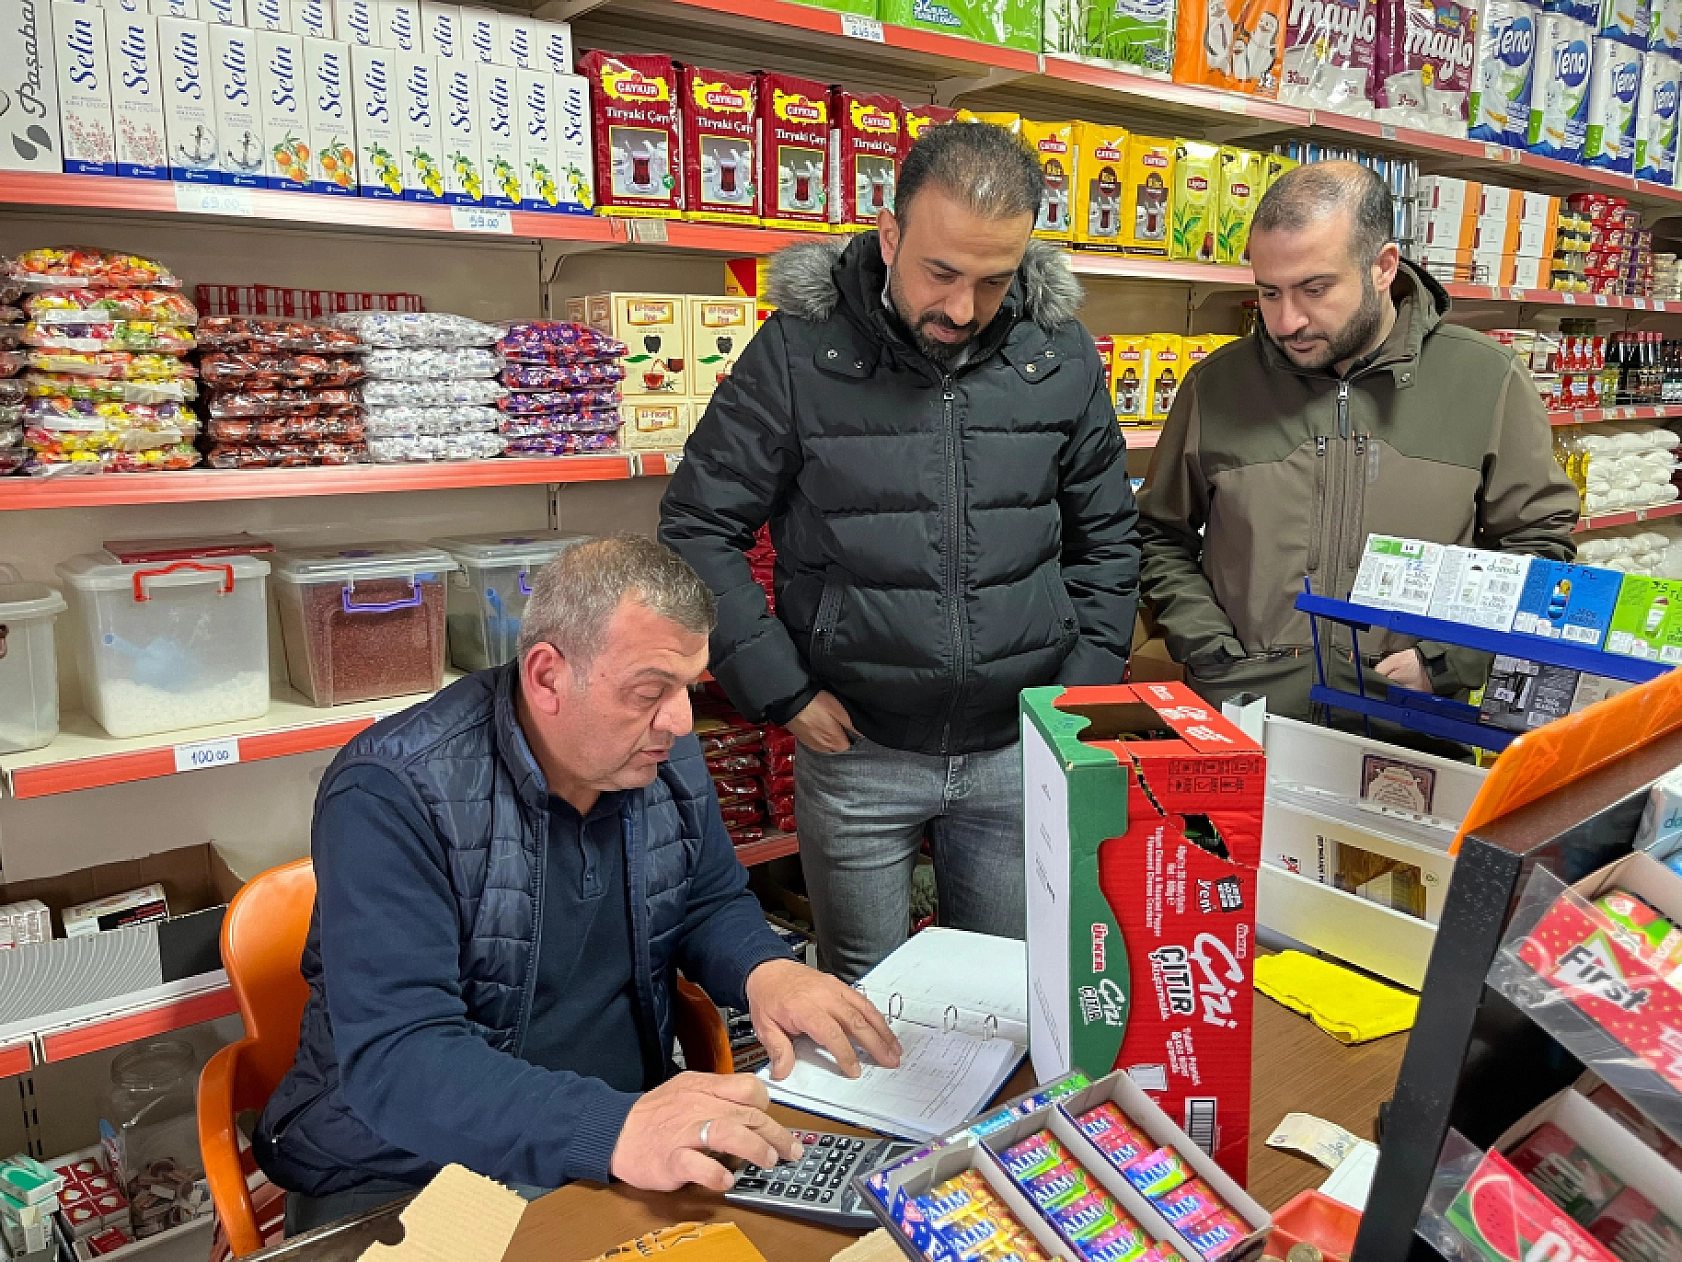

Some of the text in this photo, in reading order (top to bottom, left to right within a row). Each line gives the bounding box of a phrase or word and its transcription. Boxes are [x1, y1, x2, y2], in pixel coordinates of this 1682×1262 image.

[348, 1, 370, 45] elin
[390, 7, 411, 51] elin
[432, 15, 453, 57] elin
[473, 21, 492, 62] elin
[510, 28, 528, 68] elin
[1492, 17, 1532, 59] Teno
[66, 20, 97, 90] Selin
[120, 26, 149, 95] Selin
[173, 32, 202, 99] Selin
[223, 40, 249, 106] Selin
[269, 46, 297, 112] Selin
[546, 34, 563, 73] elin
[1404, 24, 1472, 80] maylo
[1553, 41, 1586, 81] Teno
[1612, 63, 1638, 97] Teno
[317, 53, 342, 118] Selin
[364, 60, 389, 123] Selin
[408, 66, 430, 127] Selin
[450, 72, 471, 133] Selin
[490, 77, 510, 138] Selin
[527, 83, 547, 141] Selin
[605, 106, 645, 121] Tiryaki
[563, 88, 583, 145] Selin
[696, 115, 732, 130] Tiryaki
[1091, 923, 1109, 973] ÜLKER
[1557, 943, 1651, 1012] First
